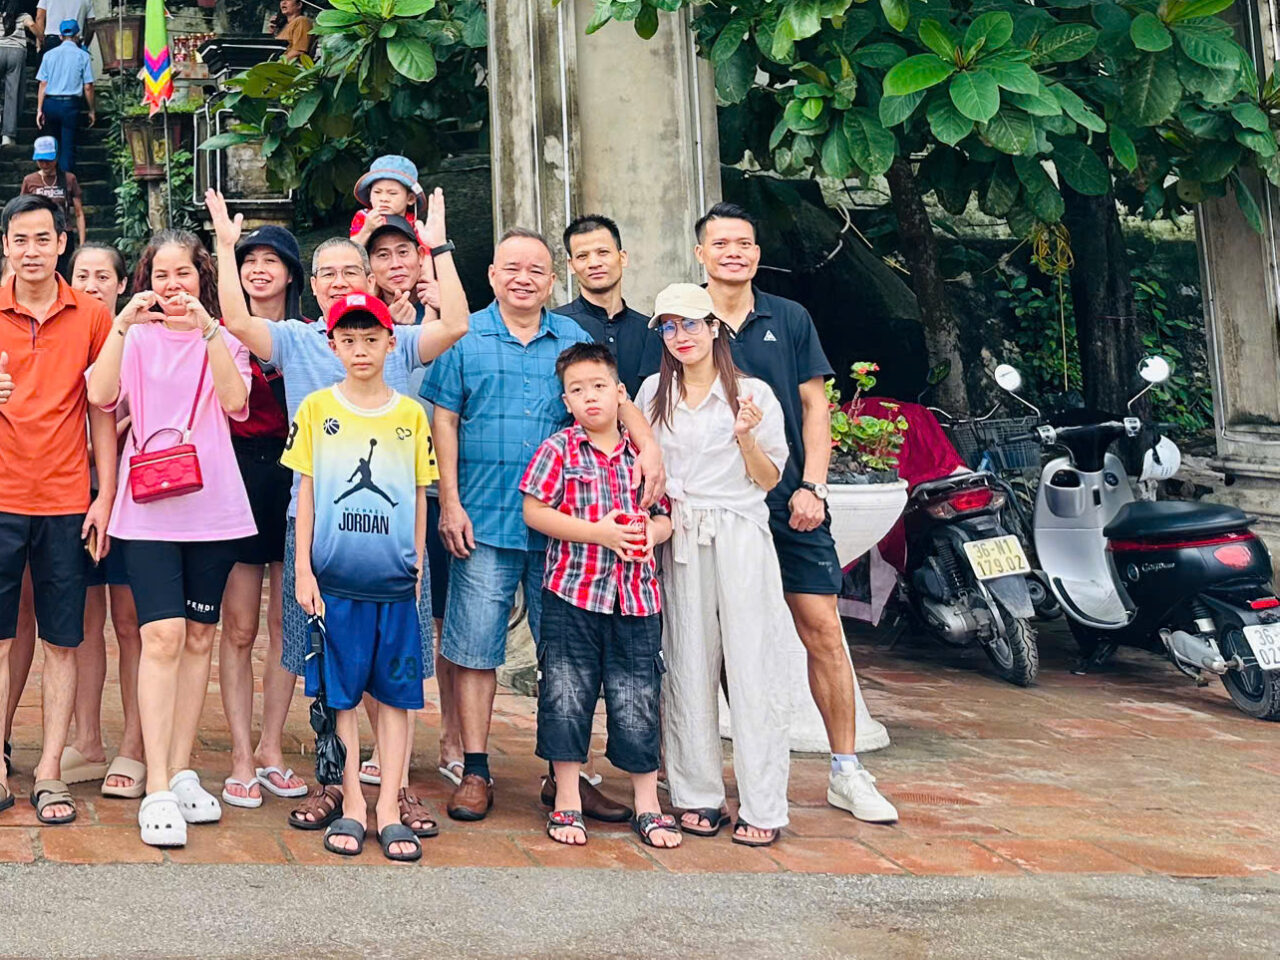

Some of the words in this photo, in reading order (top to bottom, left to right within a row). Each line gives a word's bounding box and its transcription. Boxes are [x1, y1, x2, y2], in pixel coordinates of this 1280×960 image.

[338, 511, 389, 535] JORDAN
[186, 599, 215, 612] FENDI
[1259, 647, 1280, 665] 02
